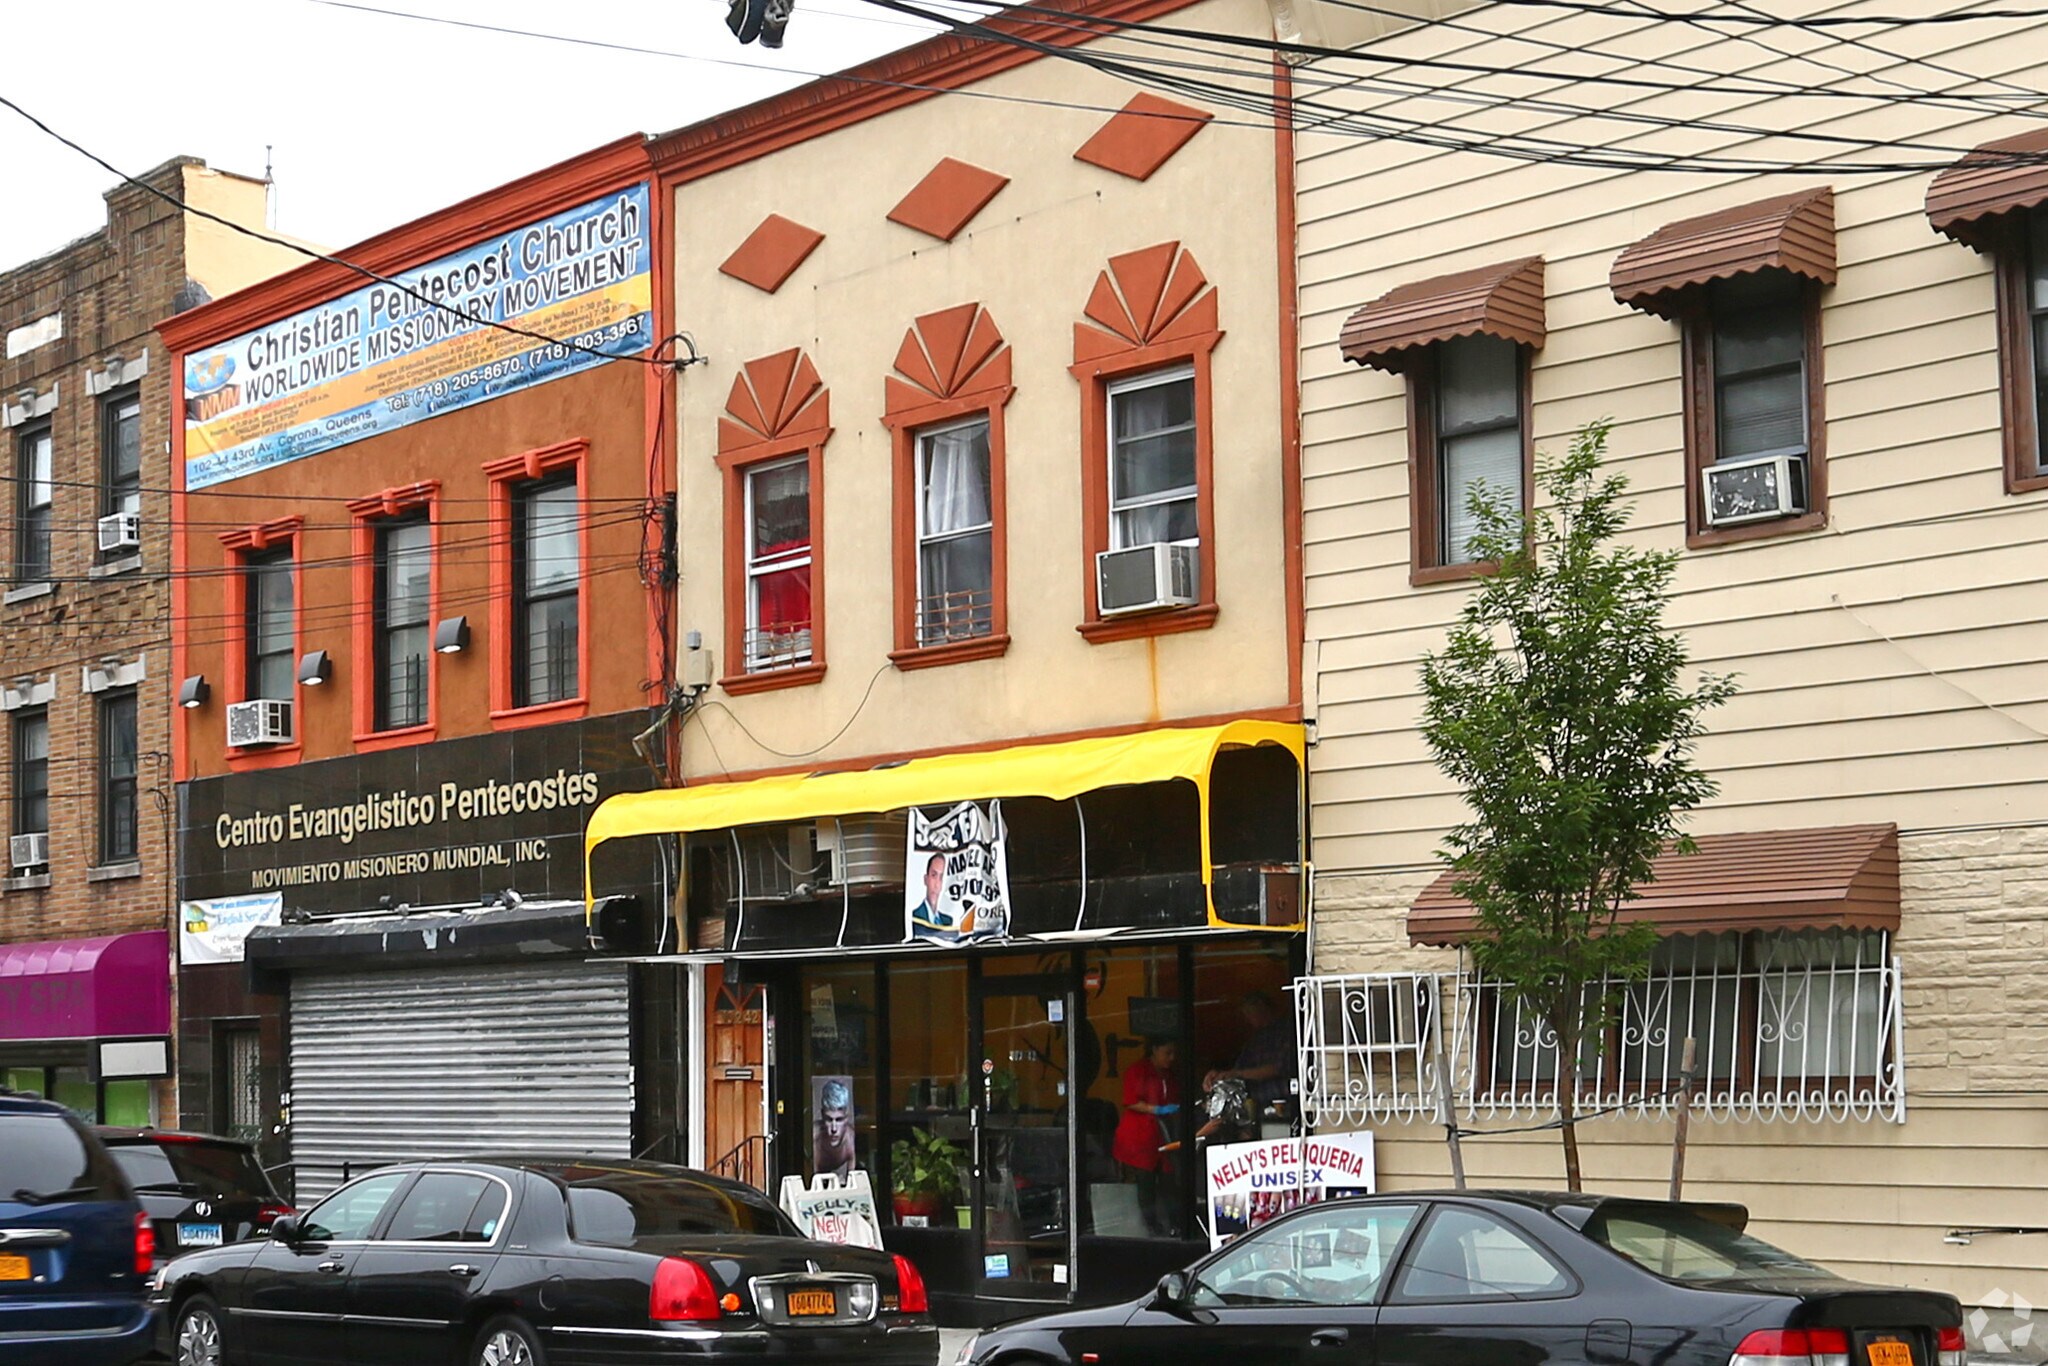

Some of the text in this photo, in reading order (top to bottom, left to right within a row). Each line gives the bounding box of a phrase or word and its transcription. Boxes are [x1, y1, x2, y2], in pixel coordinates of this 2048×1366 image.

[247, 196, 637, 371] Christian Pentecost Church
[246, 241, 640, 404] WORLDWIDE MISSIONARY MOVEMENT
[386, 394, 410, 413] Tel:
[413, 380, 449, 406] (718)
[529, 341, 570, 368] (718)
[231, 445, 254, 462] 43rd
[325, 406, 371, 432] Queens
[216, 769, 598, 848] Centro Evangelistico Pentecostes
[252, 839, 551, 888] MOVIMIENTO MISIONERO MUNDIAL, INC.
[1212, 1147, 1268, 1190] NELLY'S
[1251, 1168, 1324, 1188] UNISEX
